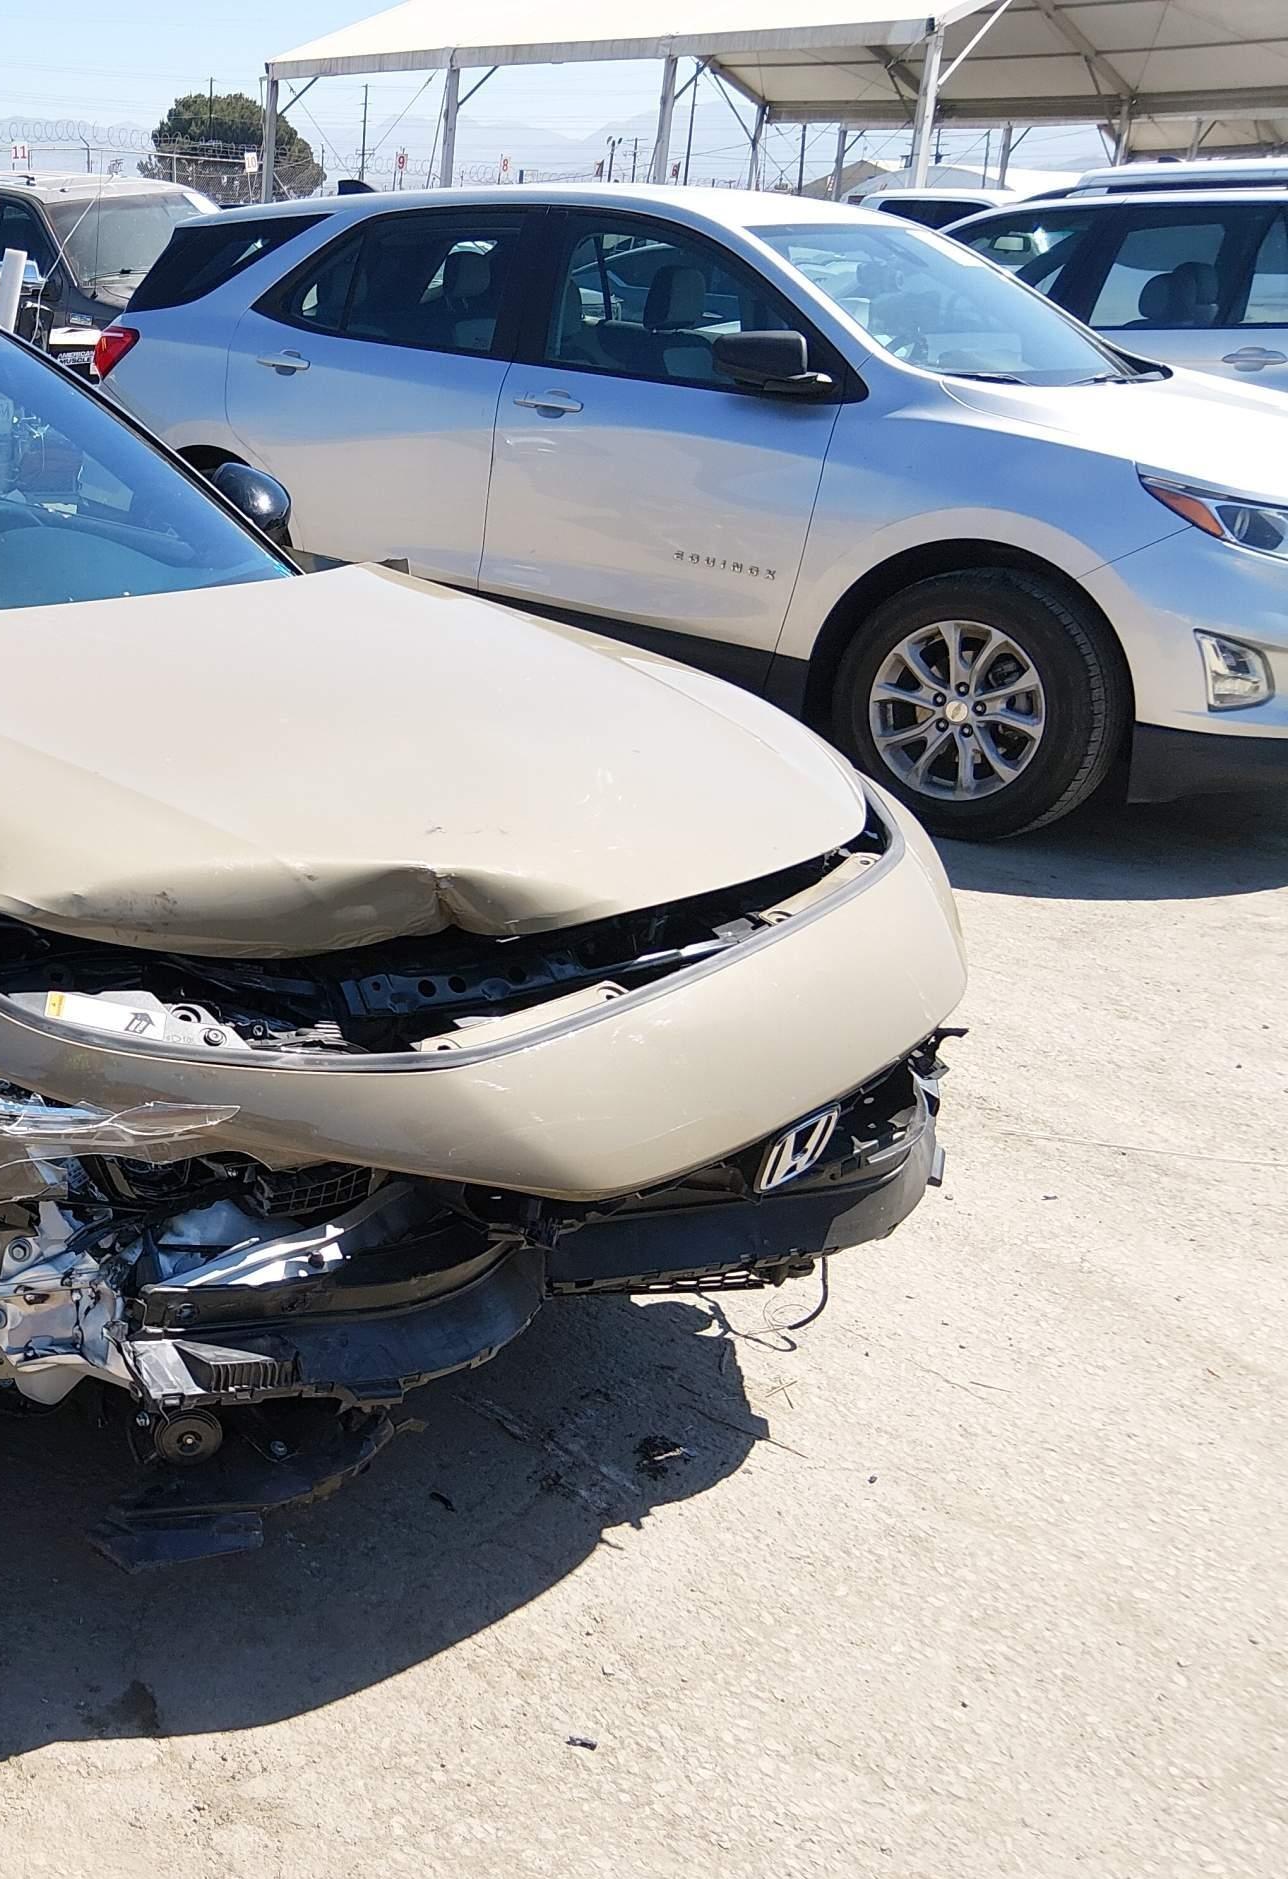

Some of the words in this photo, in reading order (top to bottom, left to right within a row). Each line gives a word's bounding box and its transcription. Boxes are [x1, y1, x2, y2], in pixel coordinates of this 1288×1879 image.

[12, 145, 27, 160] 11
[246, 156, 257, 169] 10
[672, 550, 777, 581] EQUINOX
